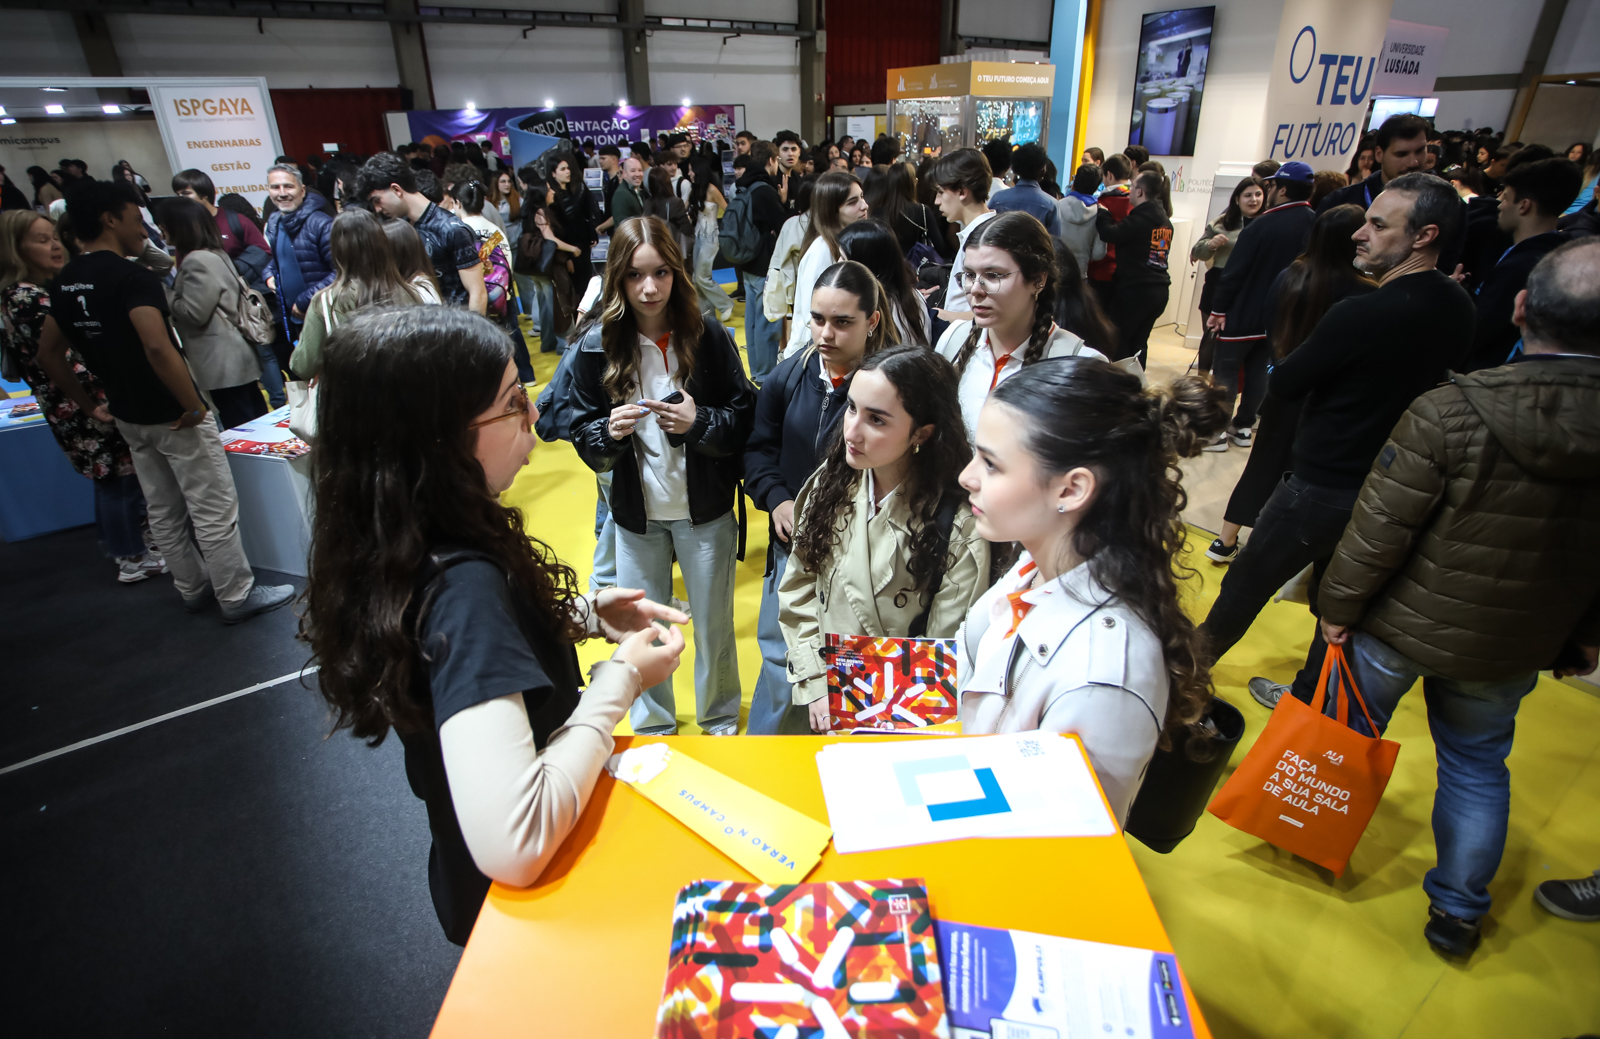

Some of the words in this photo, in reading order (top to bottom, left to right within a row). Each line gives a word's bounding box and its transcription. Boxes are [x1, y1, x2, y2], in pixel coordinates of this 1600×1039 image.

[1389, 42, 1426, 56] UNIVERSIDADE
[1289, 25, 1317, 84] O
[1316, 54, 1376, 106] TEU
[1384, 56, 1421, 76] LUSÍADA
[983, 75, 994, 83] TEU
[994, 75, 1016, 83] FUTURO
[1016, 76, 1037, 85] COMEÇA
[1037, 76, 1050, 84] AQUI
[173, 98, 254, 116] ISPGAYA
[186, 138, 262, 150] ENGENHARIAS
[1269, 122, 1356, 160] FUTURO
[210, 160, 251, 172] GESTÃO
[215, 184, 270, 195] NTABILIDA
[1282, 749, 1317, 775] FAÇA
[1275, 760, 1297, 777] DO
[1297, 773, 1350, 801] MUNDO
[1262, 781, 1283, 797] DE
[1281, 794, 1319, 816] AULA
[1269, 772, 1280, 782] A
[1282, 778, 1310, 798] SUA
[1312, 793, 1349, 815] SALA
[678, 789, 726, 822] CAMPUS
